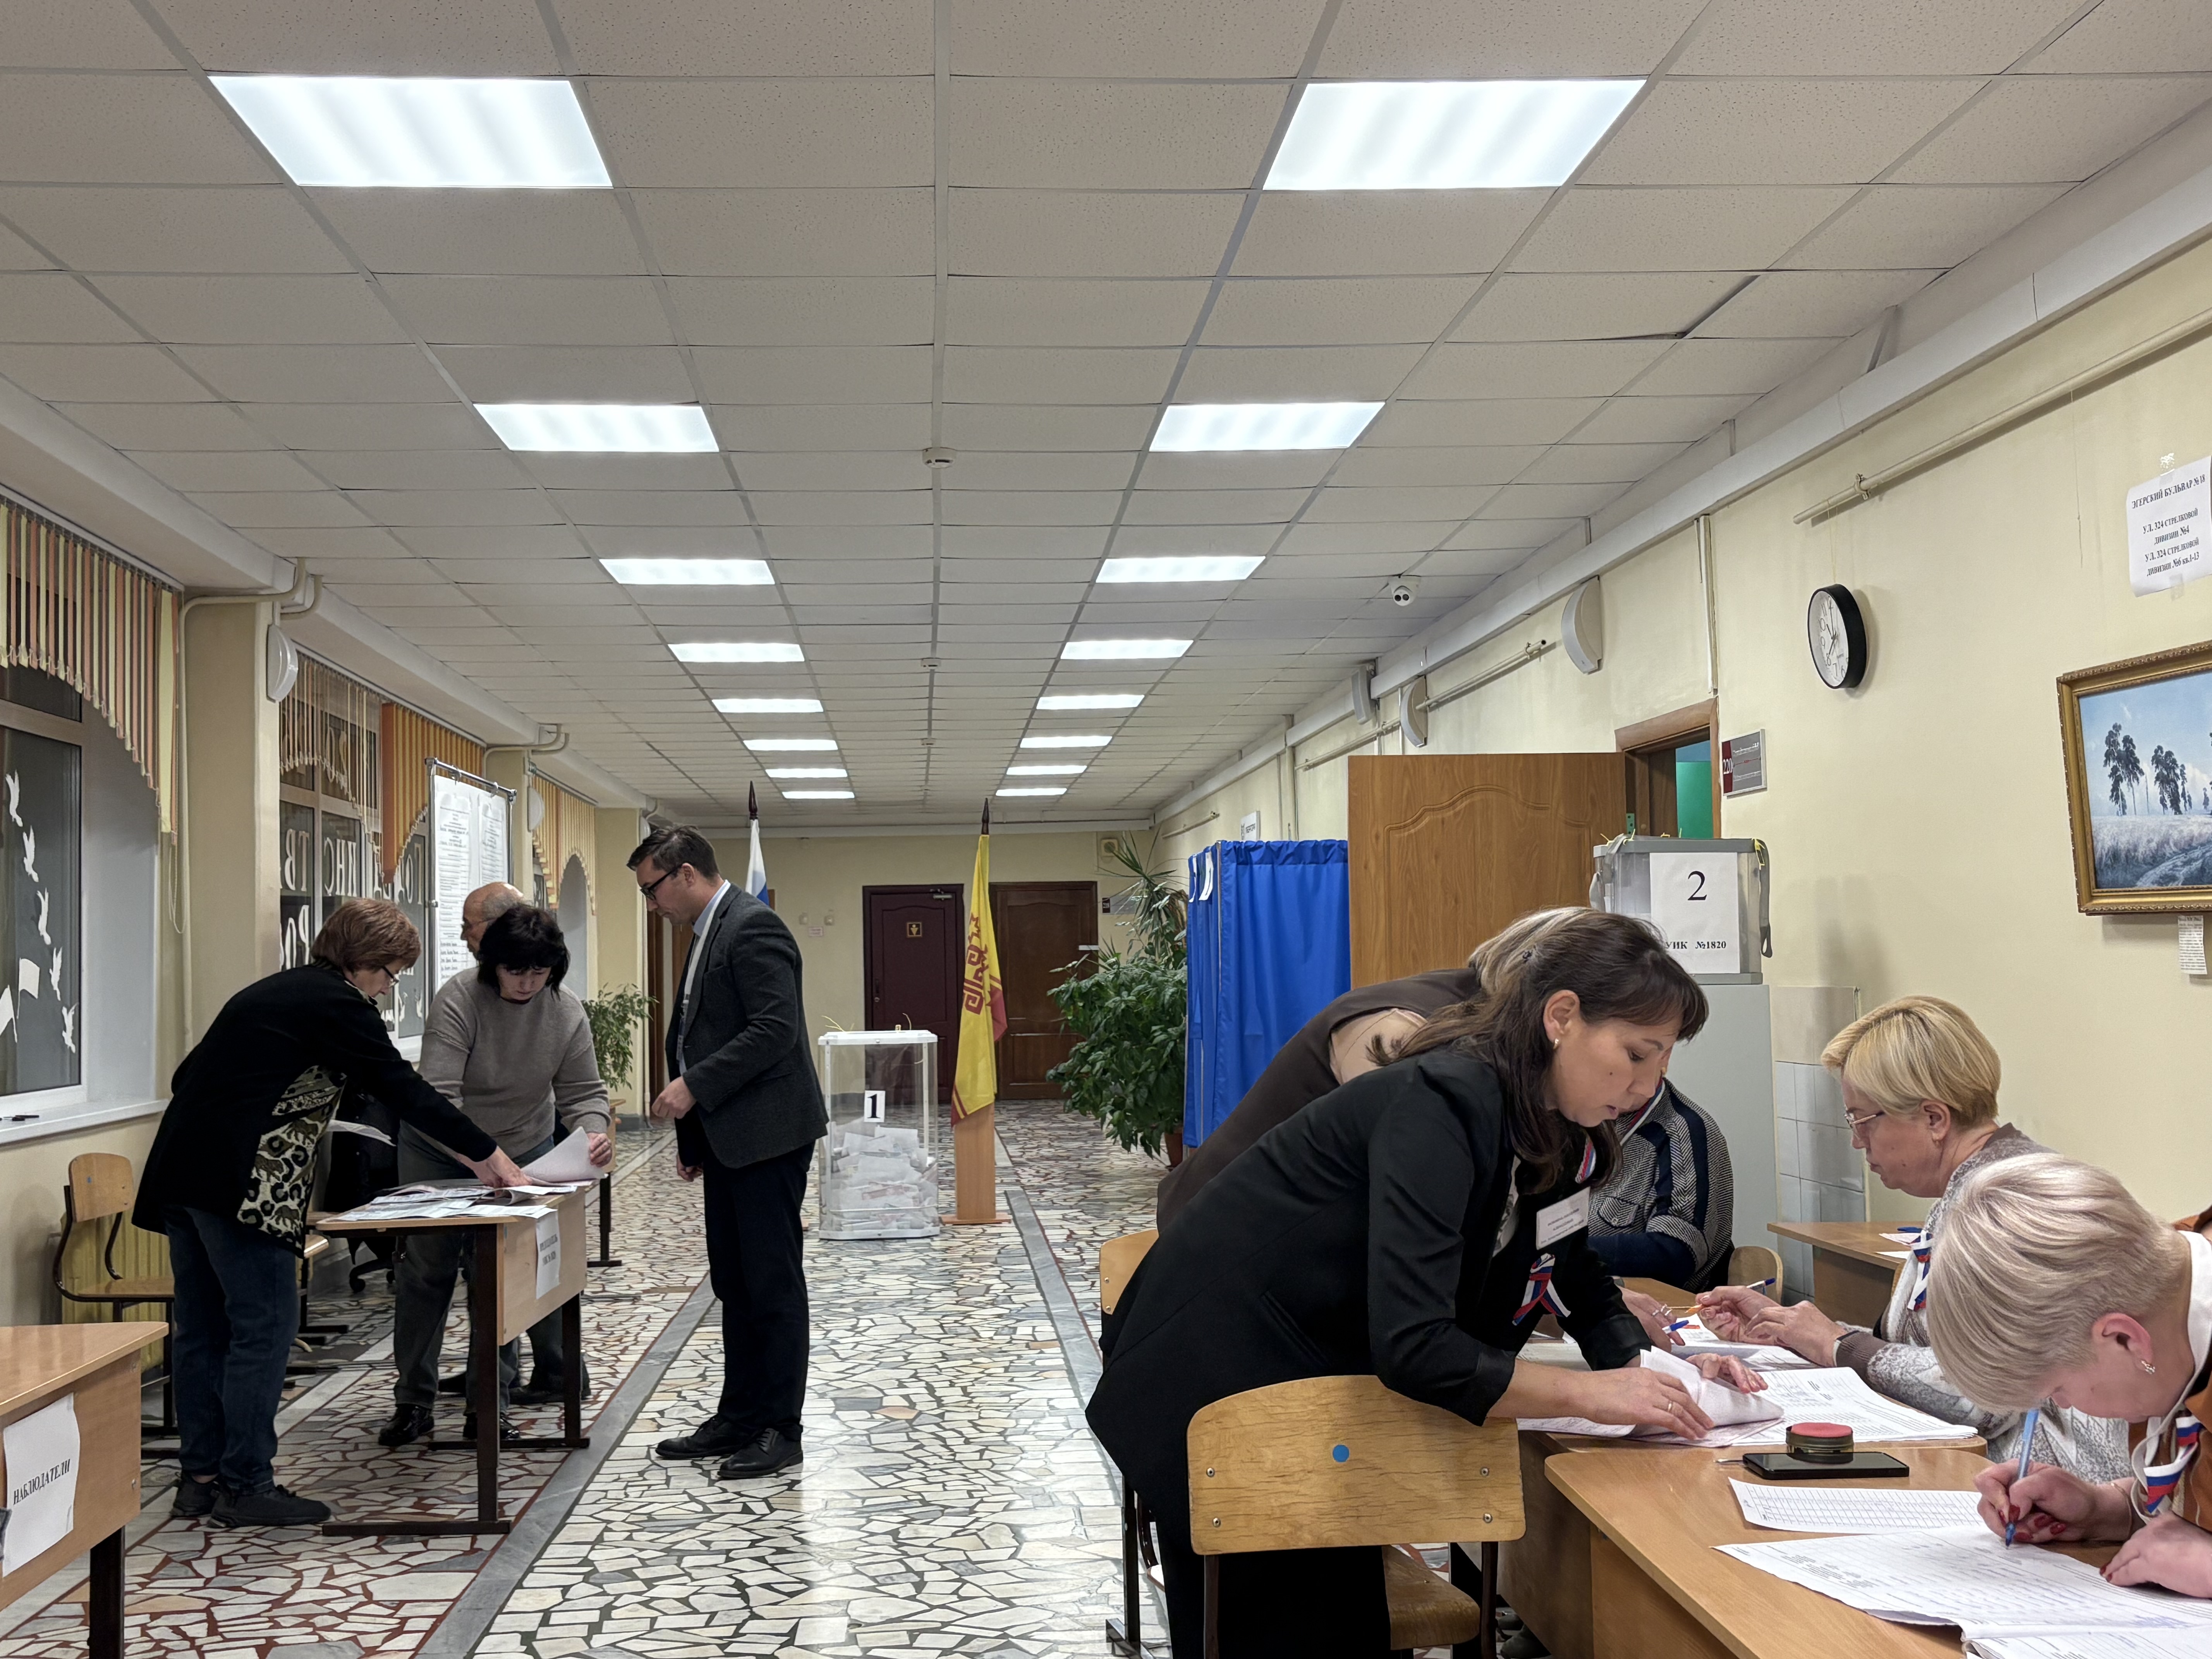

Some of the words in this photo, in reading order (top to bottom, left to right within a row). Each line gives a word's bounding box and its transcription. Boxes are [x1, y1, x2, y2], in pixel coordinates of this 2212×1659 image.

[2132, 489, 2163, 508] ЭГЕРСКИЙ
[2164, 479, 2192, 497] БУЛЬВАР
[2143, 524, 2154, 534] УЛ.
[2155, 520, 2164, 530] 324
[2164, 508, 2198, 526] СТРЕЛКОВОЙ
[2154, 530, 2178, 545] ДИВИЗИИ
[2145, 553, 2156, 562] УЛ.
[2157, 549, 2166, 558] 324
[2167, 537, 2199, 555] СТРЕЛКОВОЙ
[2147, 562, 2171, 576] ДИВИЗИИ
[1821, 603, 1827, 616] 11
[1820, 636, 1825, 649] 9
[1826, 653, 1831, 666] 8
[1832, 663, 1838, 677] 7
[1723, 758, 1733, 775] 220
[1688, 871, 1707, 901] 2
[867, 1094, 881, 1119] 1
[14, 1458, 70, 1505] НАБЛЮДАТЕЛИ
